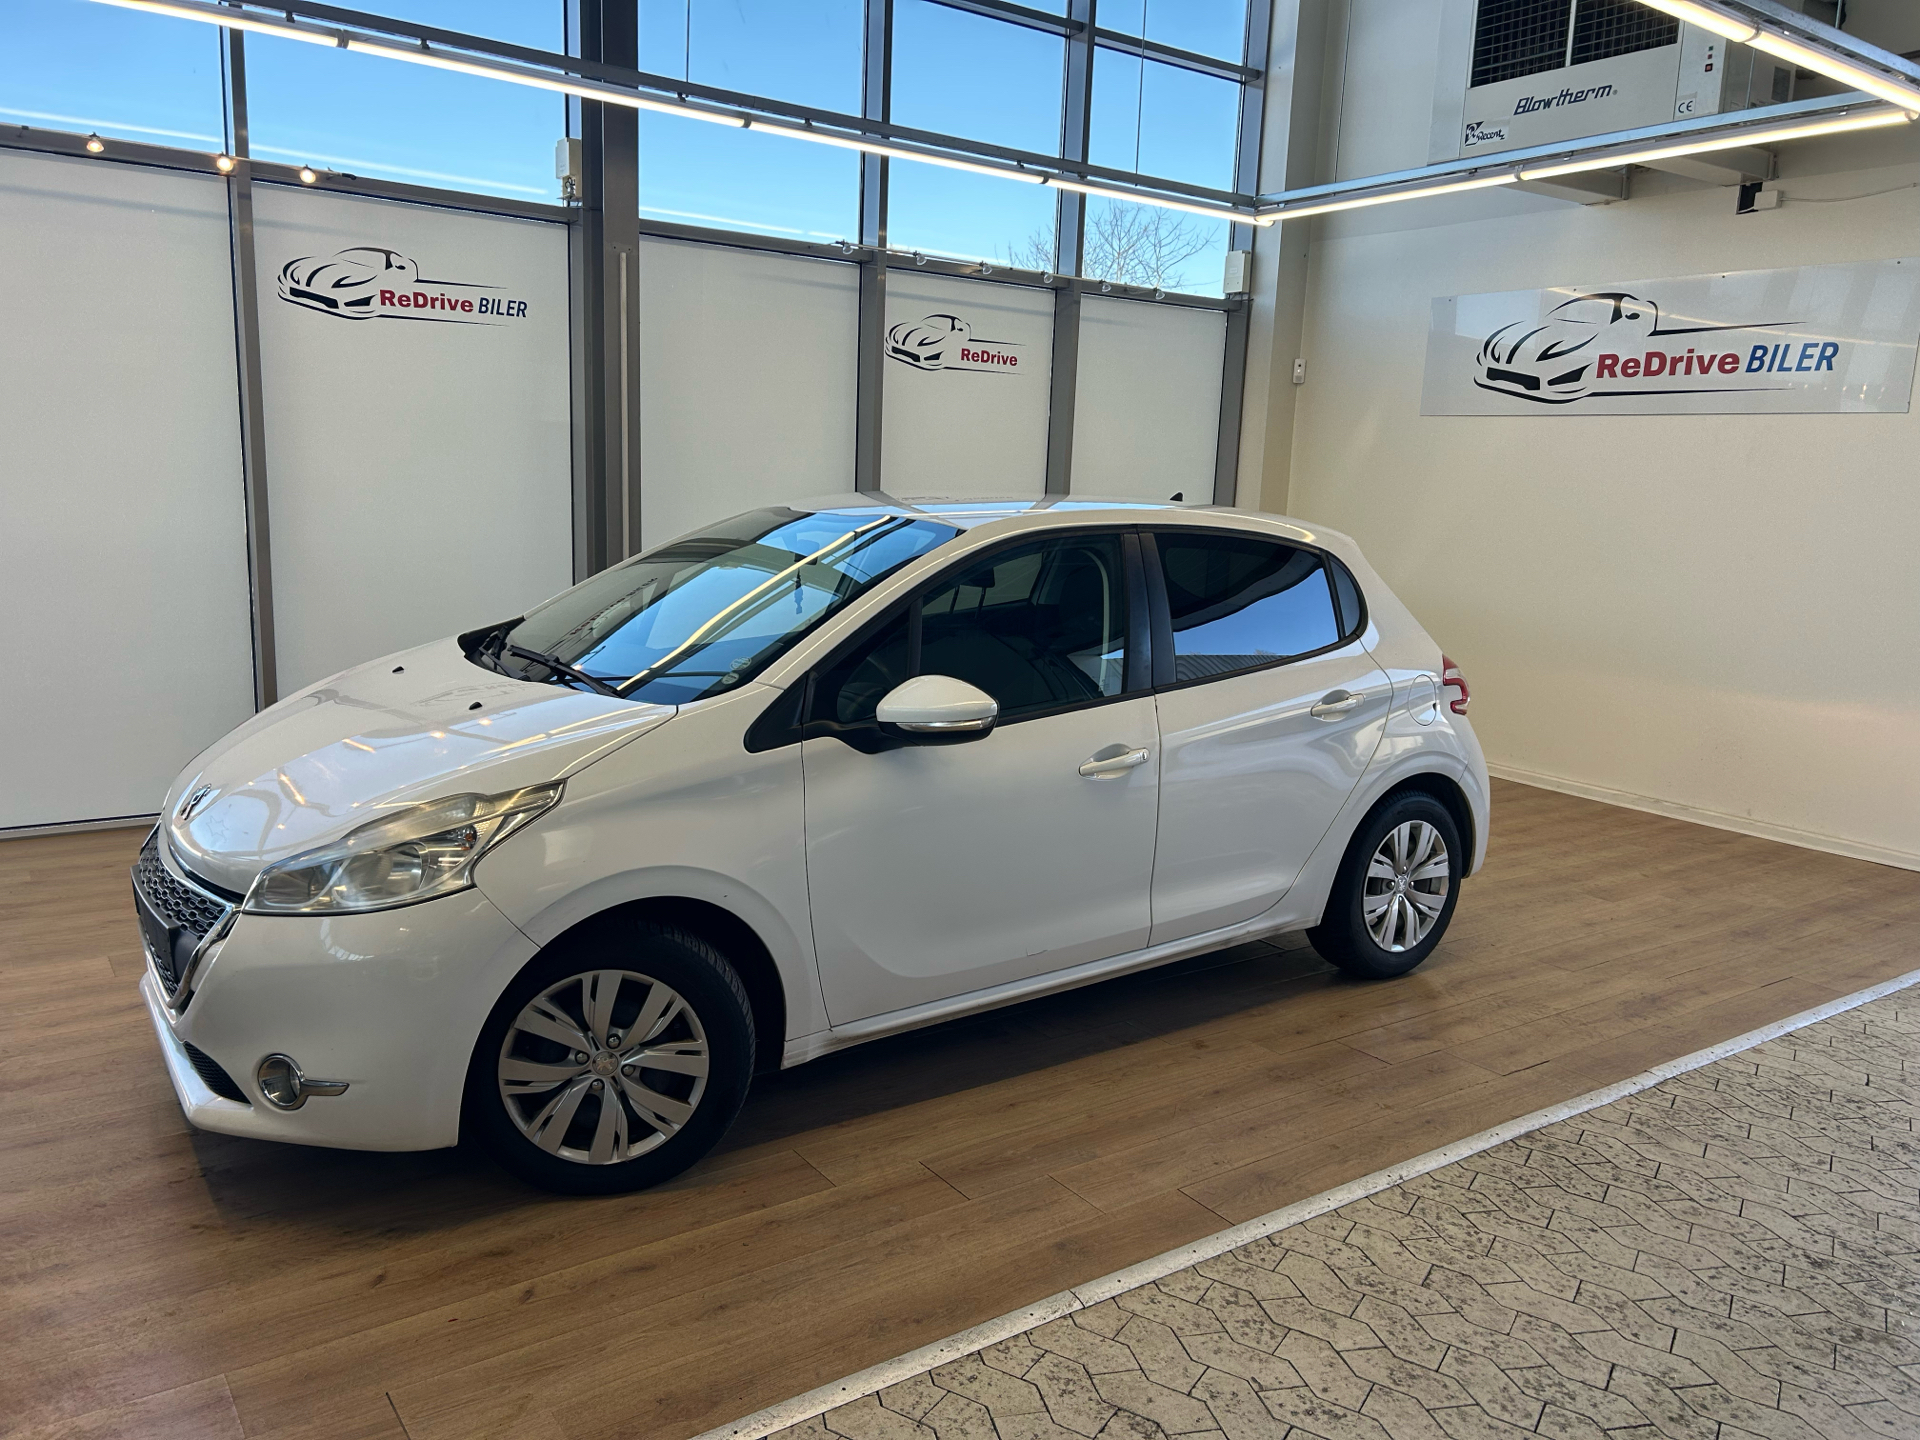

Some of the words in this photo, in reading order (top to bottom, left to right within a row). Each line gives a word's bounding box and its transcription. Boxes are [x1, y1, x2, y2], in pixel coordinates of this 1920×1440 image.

[1513, 84, 1613, 116] Blowtherm
[1678, 100, 1693, 114] CE
[380, 289, 474, 313] ReDrive
[478, 297, 528, 318] BILER
[961, 347, 1018, 367] ReDrive
[1596, 348, 1740, 379] ReDrive
[1745, 342, 1840, 373] BILER
